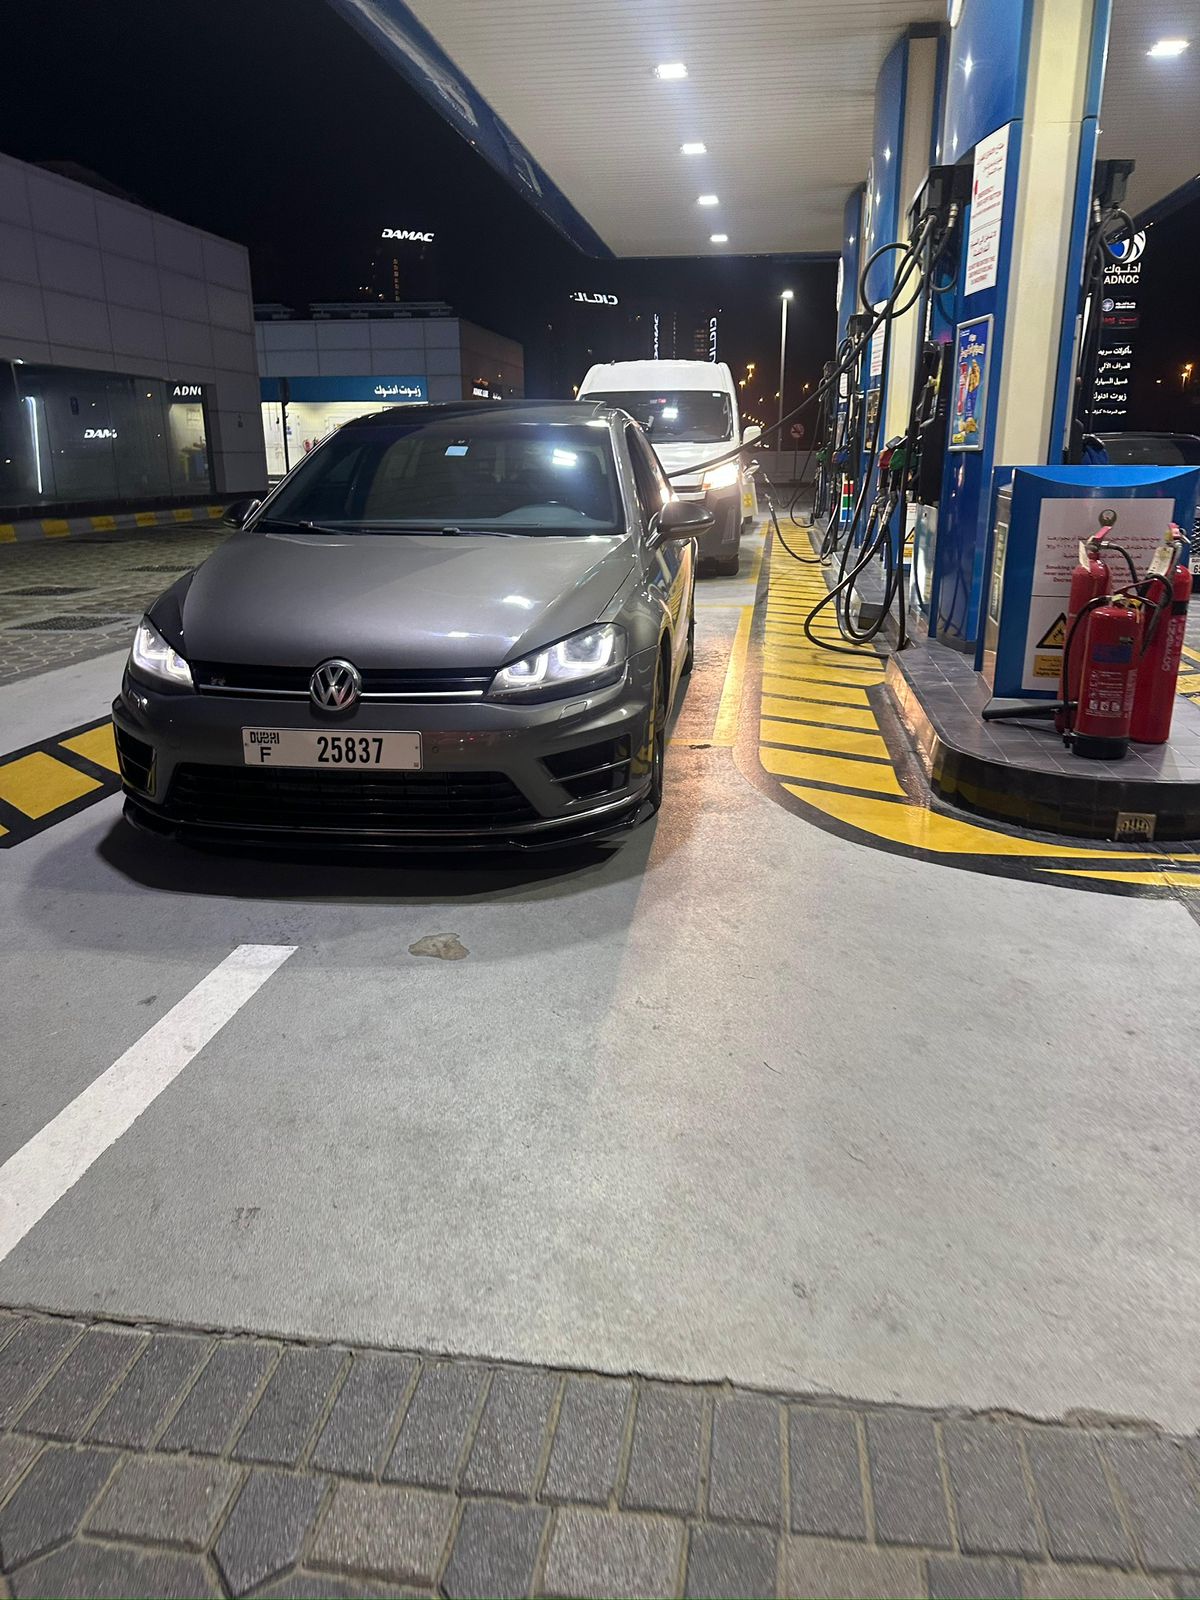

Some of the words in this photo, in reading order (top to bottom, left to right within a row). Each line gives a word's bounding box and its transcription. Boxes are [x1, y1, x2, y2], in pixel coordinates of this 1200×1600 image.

[381, 228, 435, 242] DAMAC
[1103, 275, 1140, 285] ADNOC
[84, 429, 118, 439] DAM
[249, 731, 281, 744] DUBAI
[259, 746, 272, 763] F
[317, 736, 384, 764] 25837
